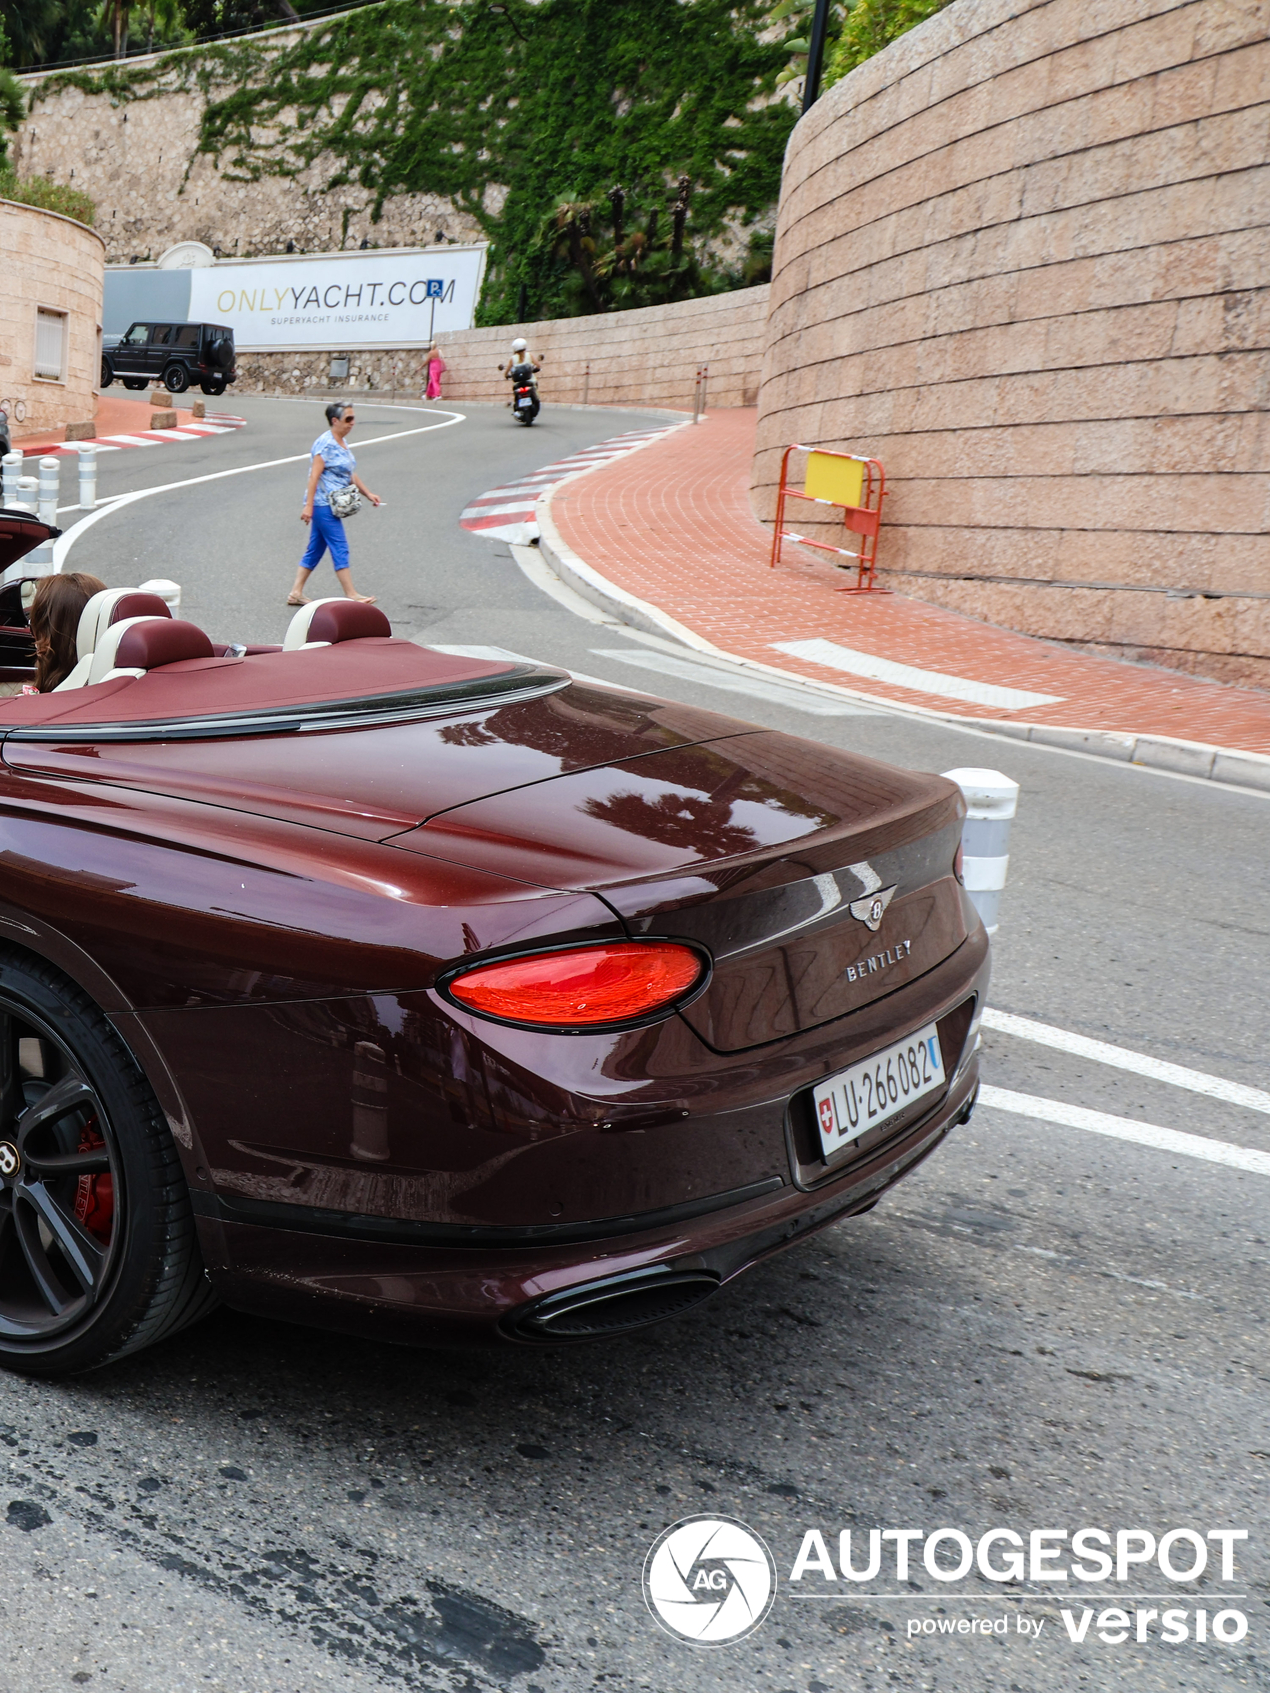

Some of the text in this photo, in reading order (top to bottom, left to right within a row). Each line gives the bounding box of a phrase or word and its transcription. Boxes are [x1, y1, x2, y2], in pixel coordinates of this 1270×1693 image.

[270, 313, 390, 325] SUPERYACHT INSURANCE
[845, 939, 912, 983] BENTLEY
